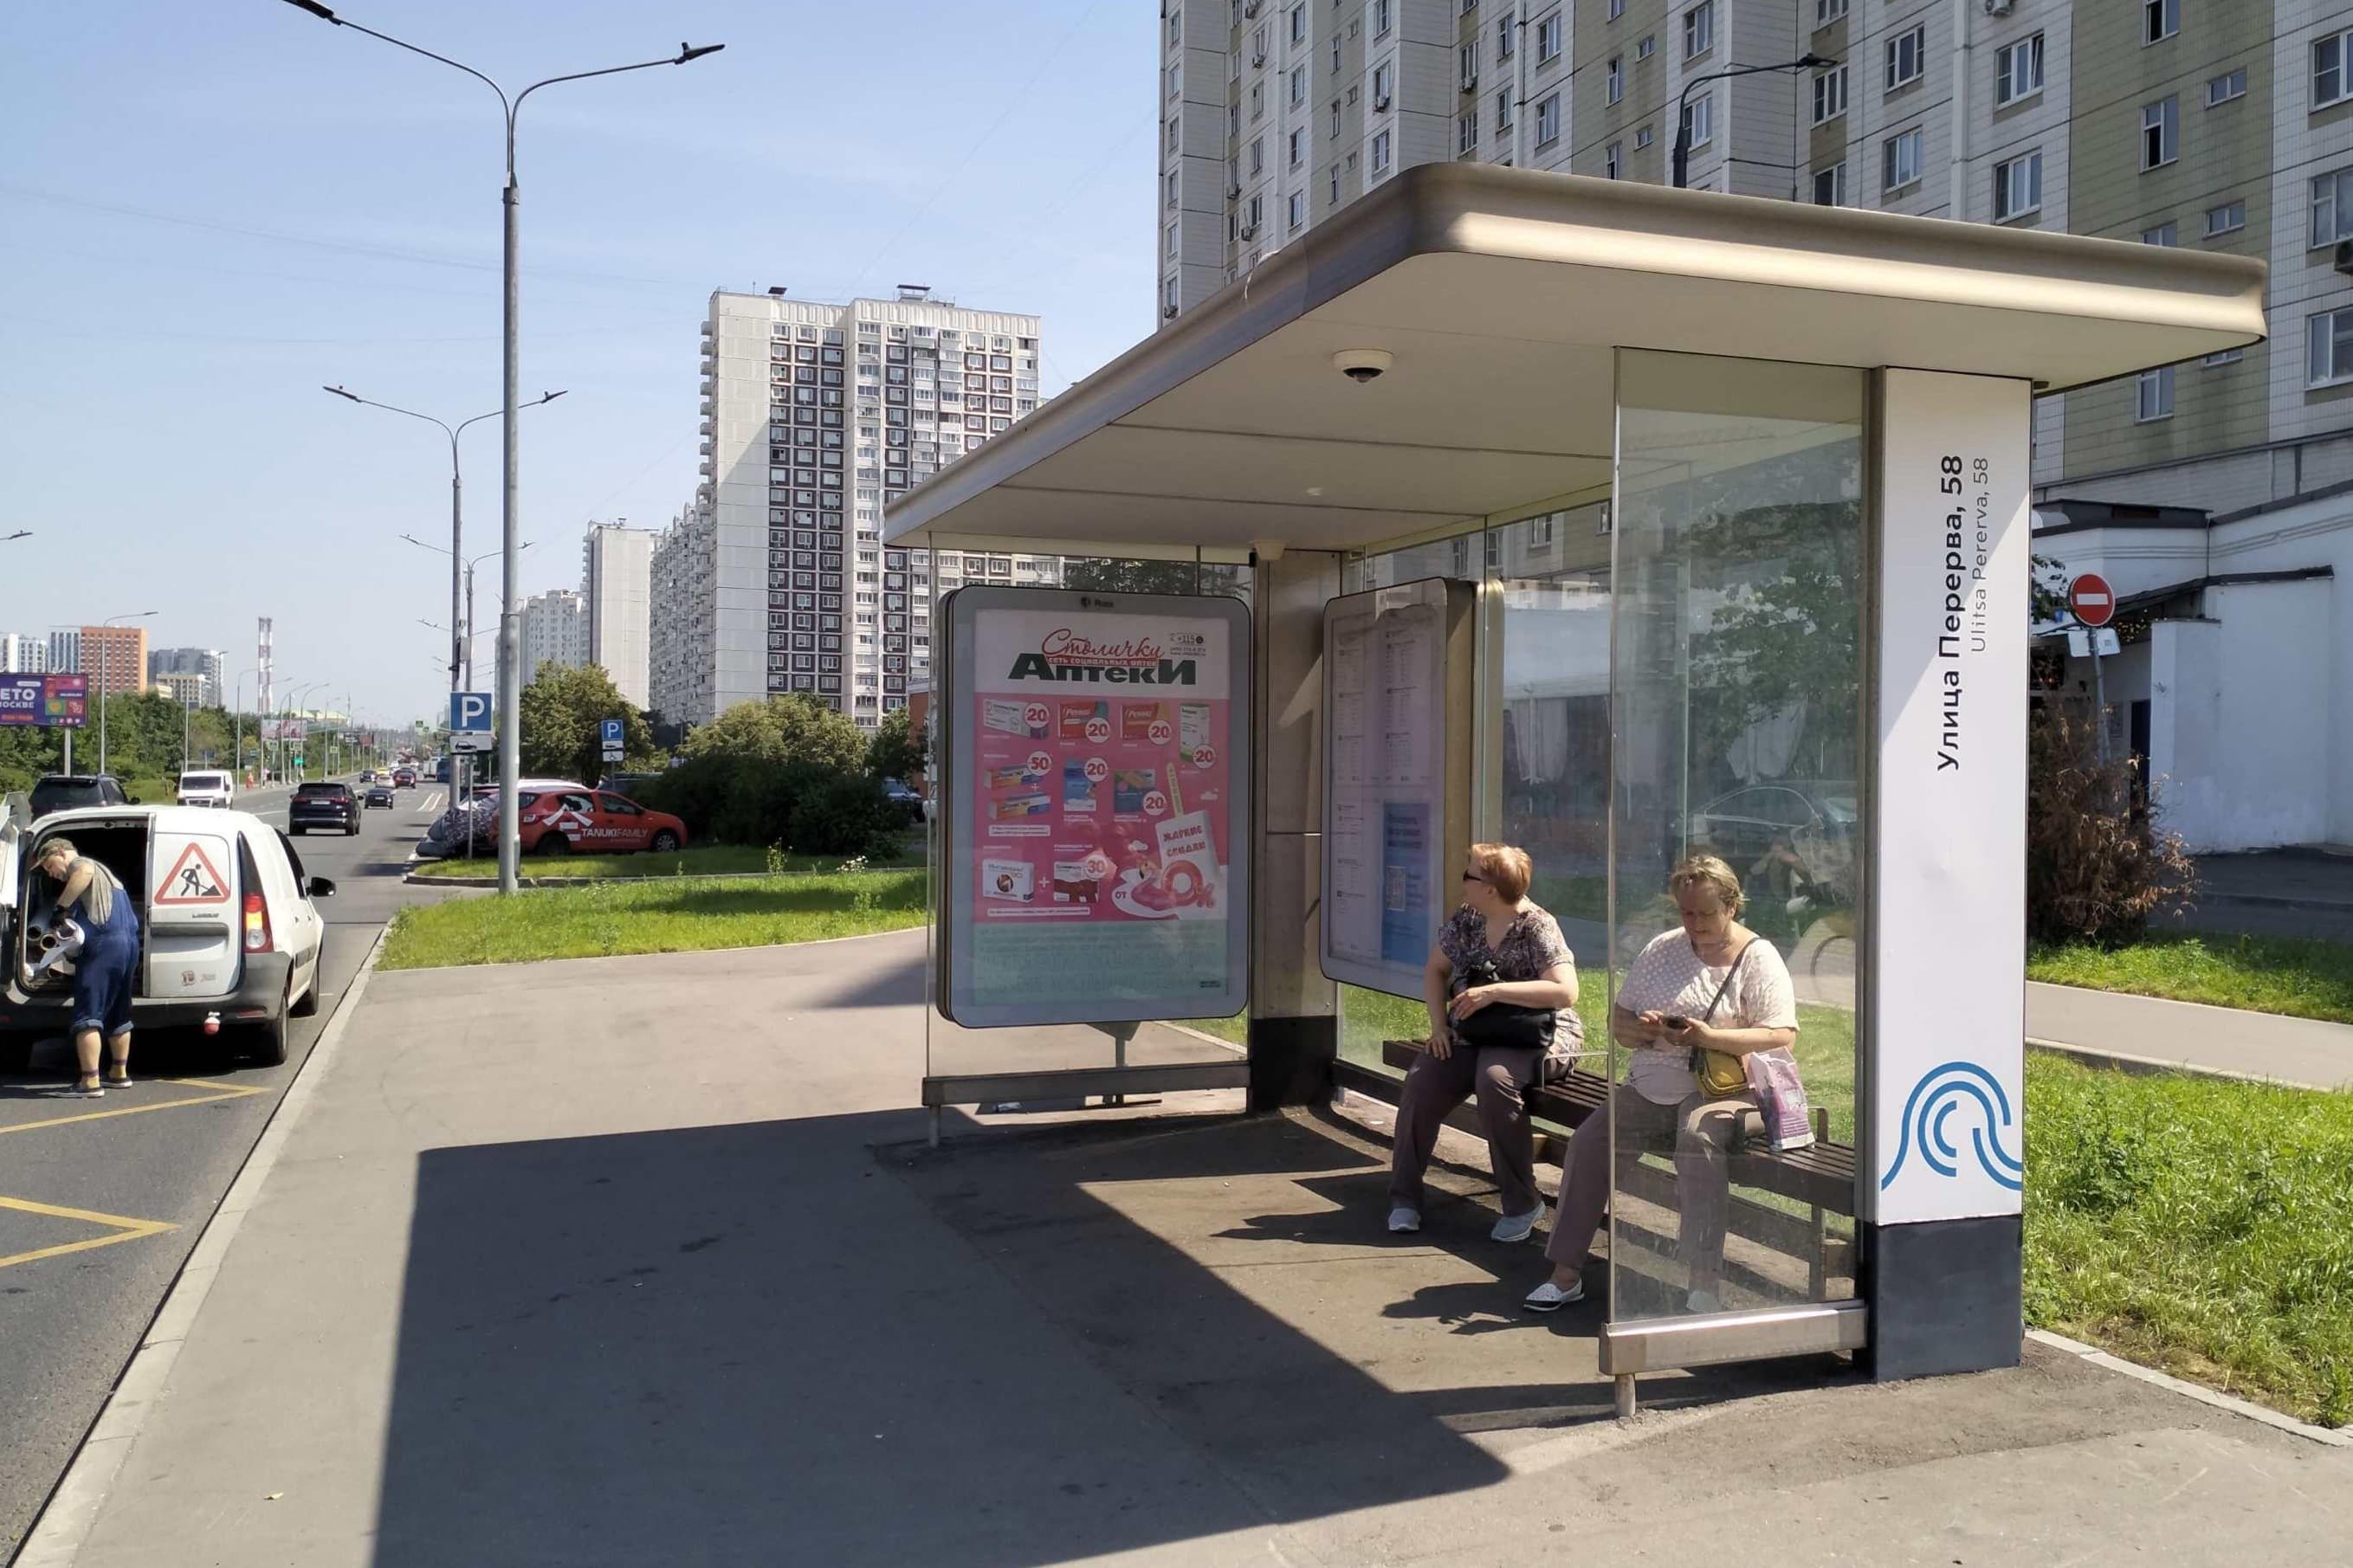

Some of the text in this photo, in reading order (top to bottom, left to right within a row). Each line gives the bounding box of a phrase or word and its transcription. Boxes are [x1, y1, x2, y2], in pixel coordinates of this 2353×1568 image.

[1971, 457, 1989, 652] Ulitsa Pererva, 58
[1937, 455, 1966, 771] Улица Перерва, 58
[1042, 629, 1165, 658] Столички
[462, 696, 485, 727] P
[608, 723, 619, 737] P
